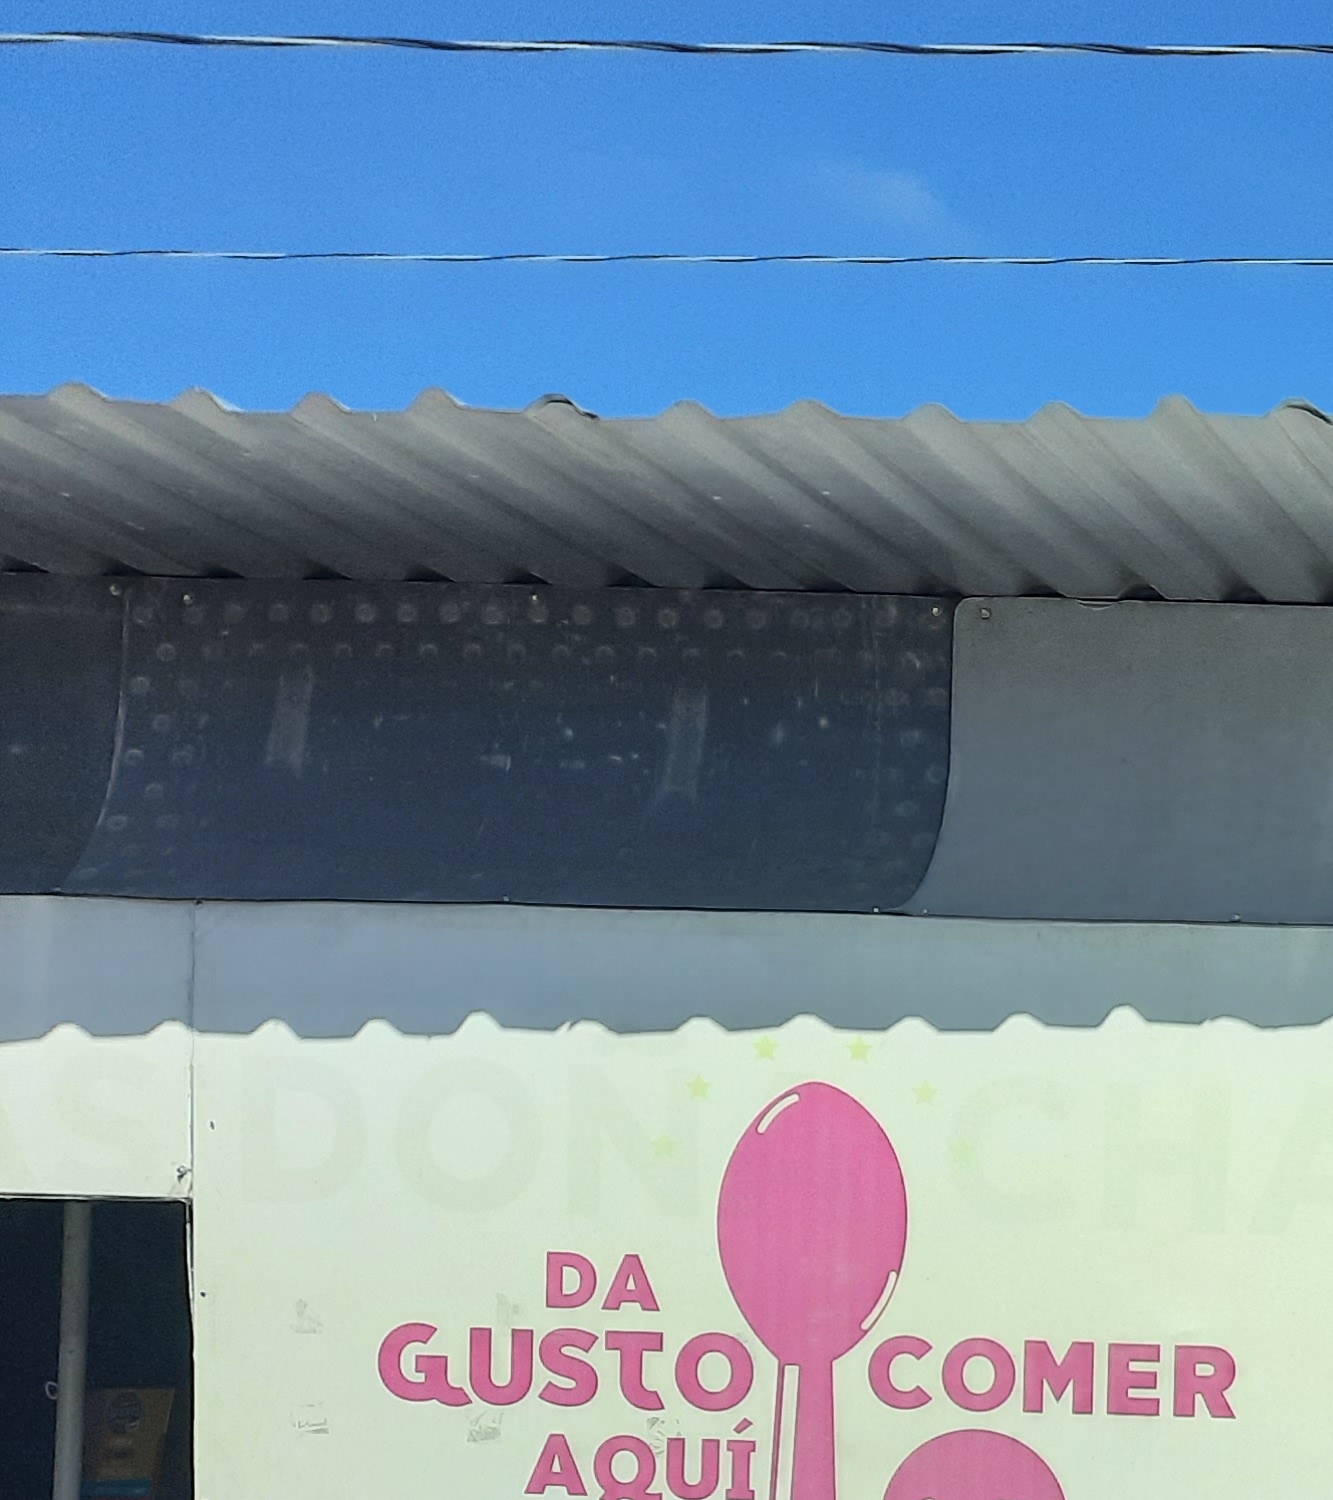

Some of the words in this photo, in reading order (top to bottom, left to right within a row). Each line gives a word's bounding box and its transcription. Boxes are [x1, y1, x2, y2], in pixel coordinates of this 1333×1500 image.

[546, 1251, 660, 1312] DA
[378, 1322, 755, 1412] GUSTO
[868, 1335, 1238, 1419] COMER
